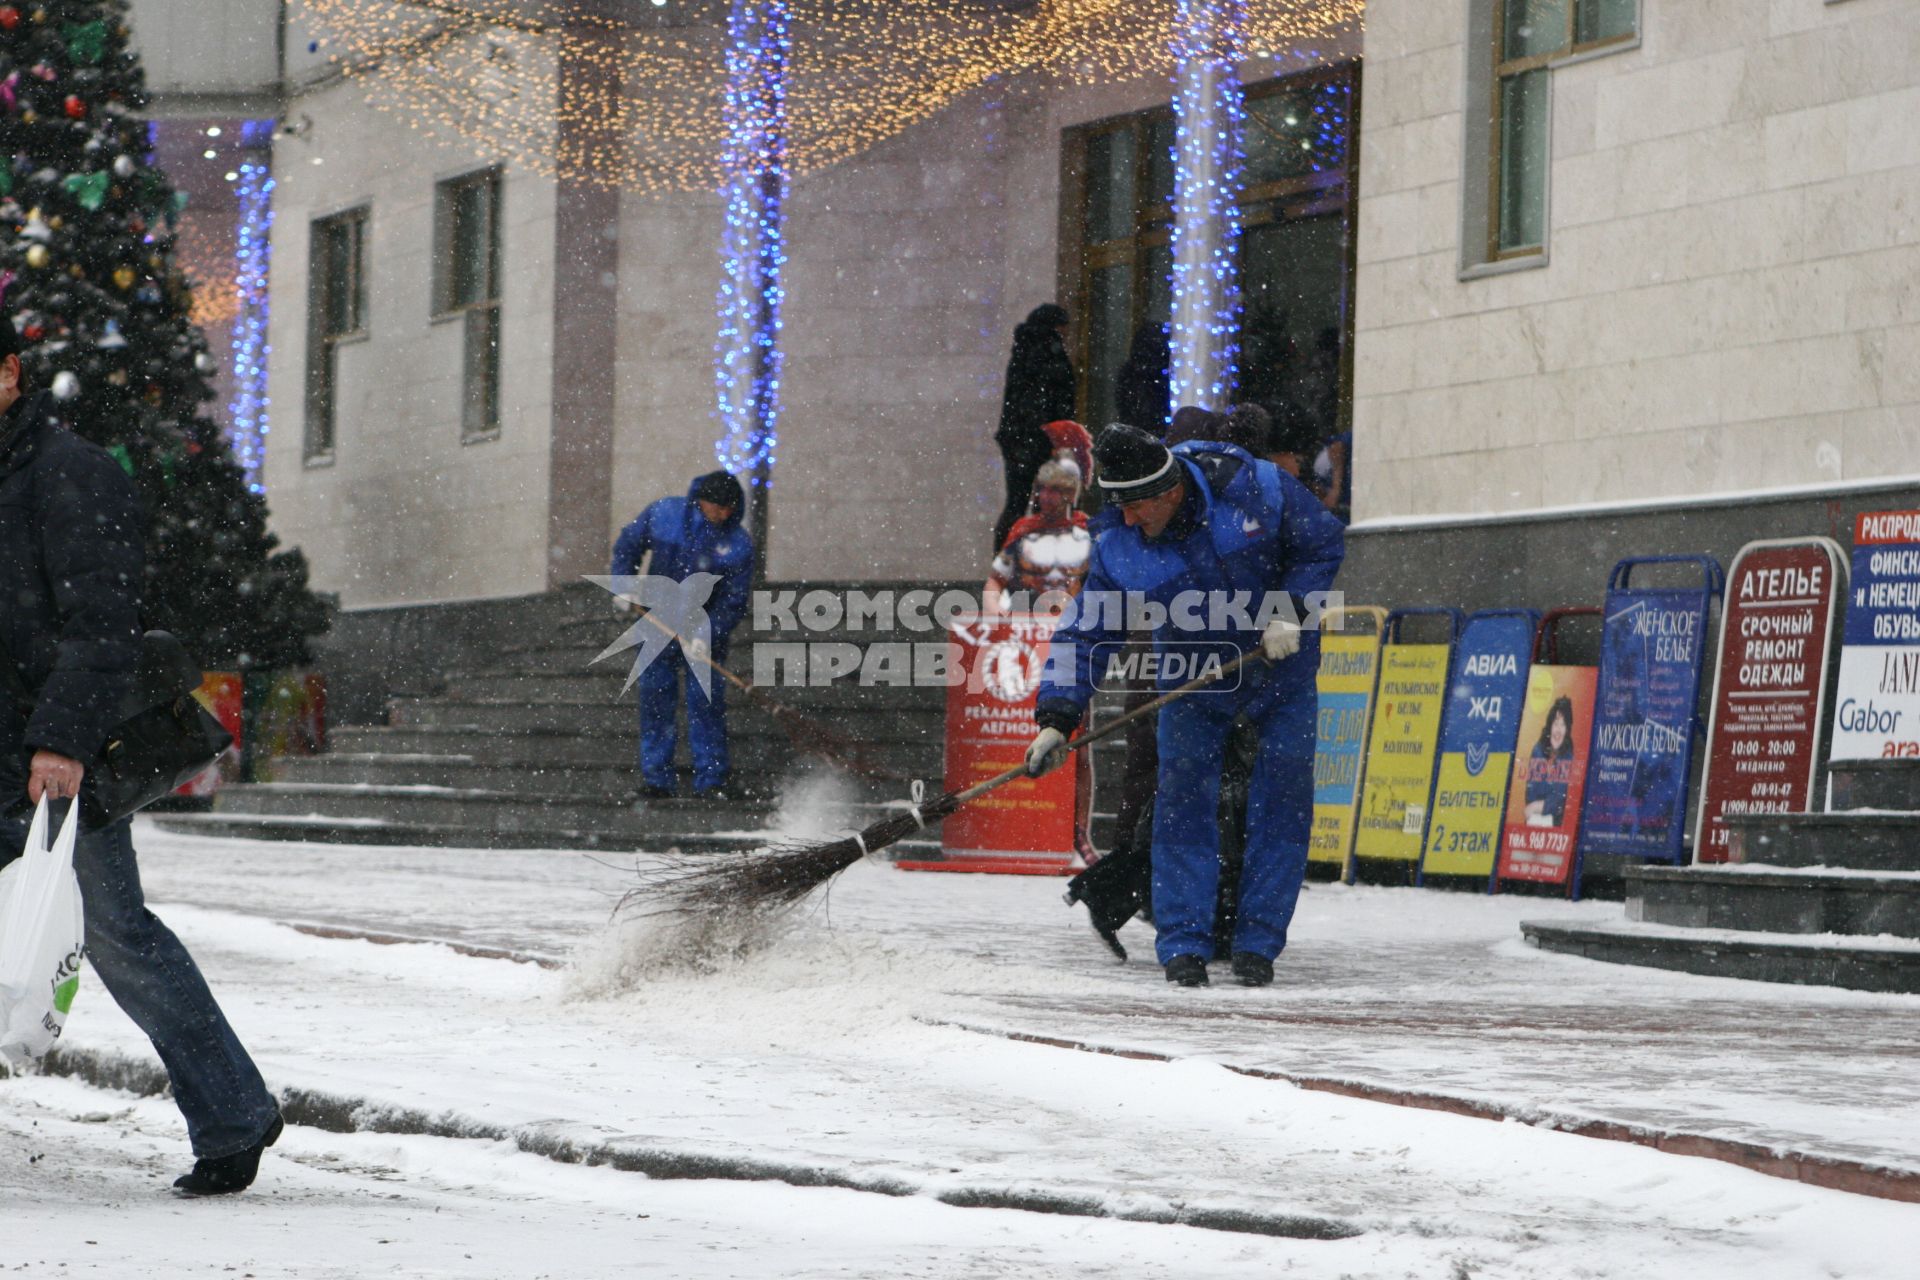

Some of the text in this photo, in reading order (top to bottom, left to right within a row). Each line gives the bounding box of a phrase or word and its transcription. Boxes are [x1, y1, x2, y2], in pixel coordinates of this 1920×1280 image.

[1740, 566, 1822, 598] АТЕЛЬЕ
[976, 622, 992, 646] 2
[1633, 610, 1695, 636] ЖЕНСКОЕ
[1741, 608, 1813, 636] СРОЧНЫЙ
[1874, 613, 1920, 639] ОБУВЬ
[1655, 637, 1693, 662] БЕЛЬЕ
[1745, 638, 1805, 660] РЕМОНТ
[1319, 652, 1373, 676] УПАЛЬНИКИ
[1464, 654, 1517, 676] АВИА
[1739, 663, 1805, 687] ОДЕЖДЫ
[1879, 651, 1920, 695] JANI
[964, 705, 1035, 719] РЕКЛАМН
[1467, 697, 1502, 722] ЖД
[1839, 698, 1902, 734] Gabor
[1318, 707, 1336, 741] СЕ
[1597, 724, 1684, 753] МУЖСКОЕ БЕЛЬЕ
[1731, 740, 1759, 756] 10:00
[1767, 740, 1796, 756] 20:00
[1736, 761, 1785, 773] ЕЖЕДНЕВНО
[1439, 791, 1499, 807] БИЛЕТЫ
[1751, 783, 1792, 797] 678-91-47
[1432, 825, 1492, 852] 2 этаж
[1546, 833, 1568, 853] 7737
